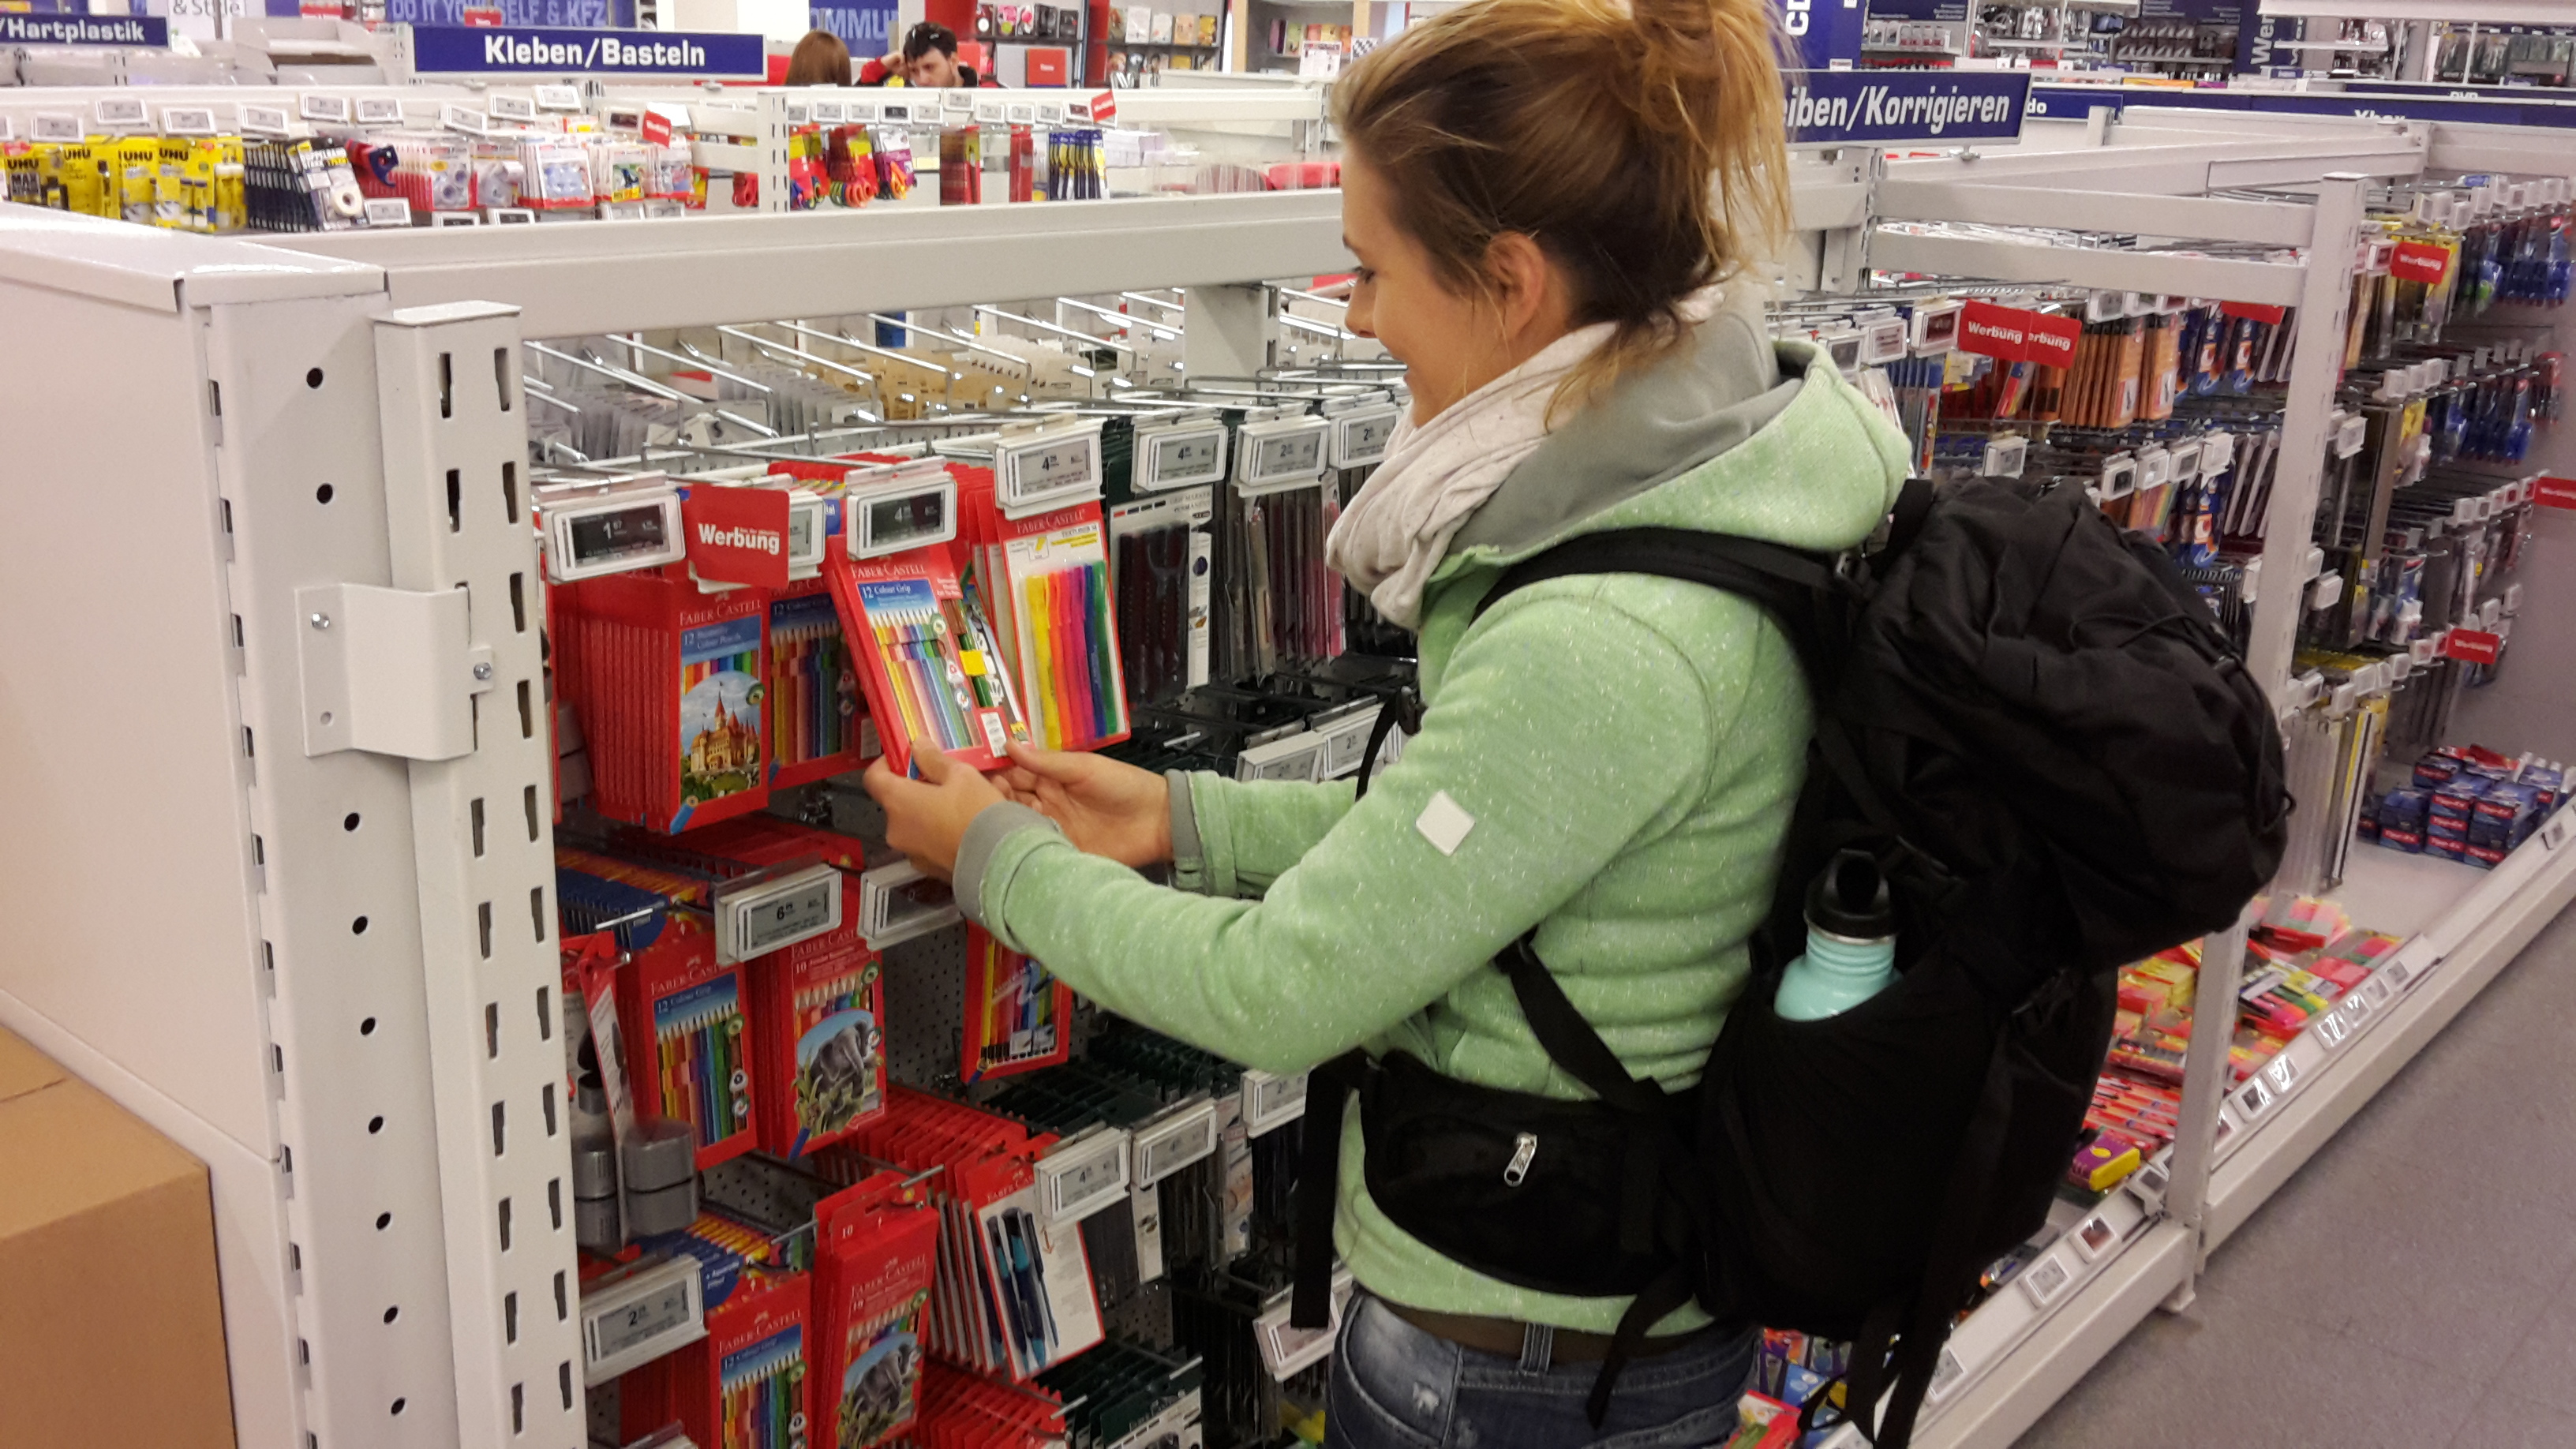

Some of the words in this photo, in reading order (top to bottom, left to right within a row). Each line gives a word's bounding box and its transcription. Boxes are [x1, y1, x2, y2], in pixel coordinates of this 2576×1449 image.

[484, 34, 706, 69] Kleben/Basteln
[1784, 85, 2010, 134] iben/Korrigieren
[123, 150, 153, 162] UHU
[159, 148, 189, 162] UHU
[1968, 320, 2024, 345] Werbung
[2027, 331, 2072, 352] erbung
[698, 522, 781, 556] Werbung
[862, 586, 874, 600] 12
